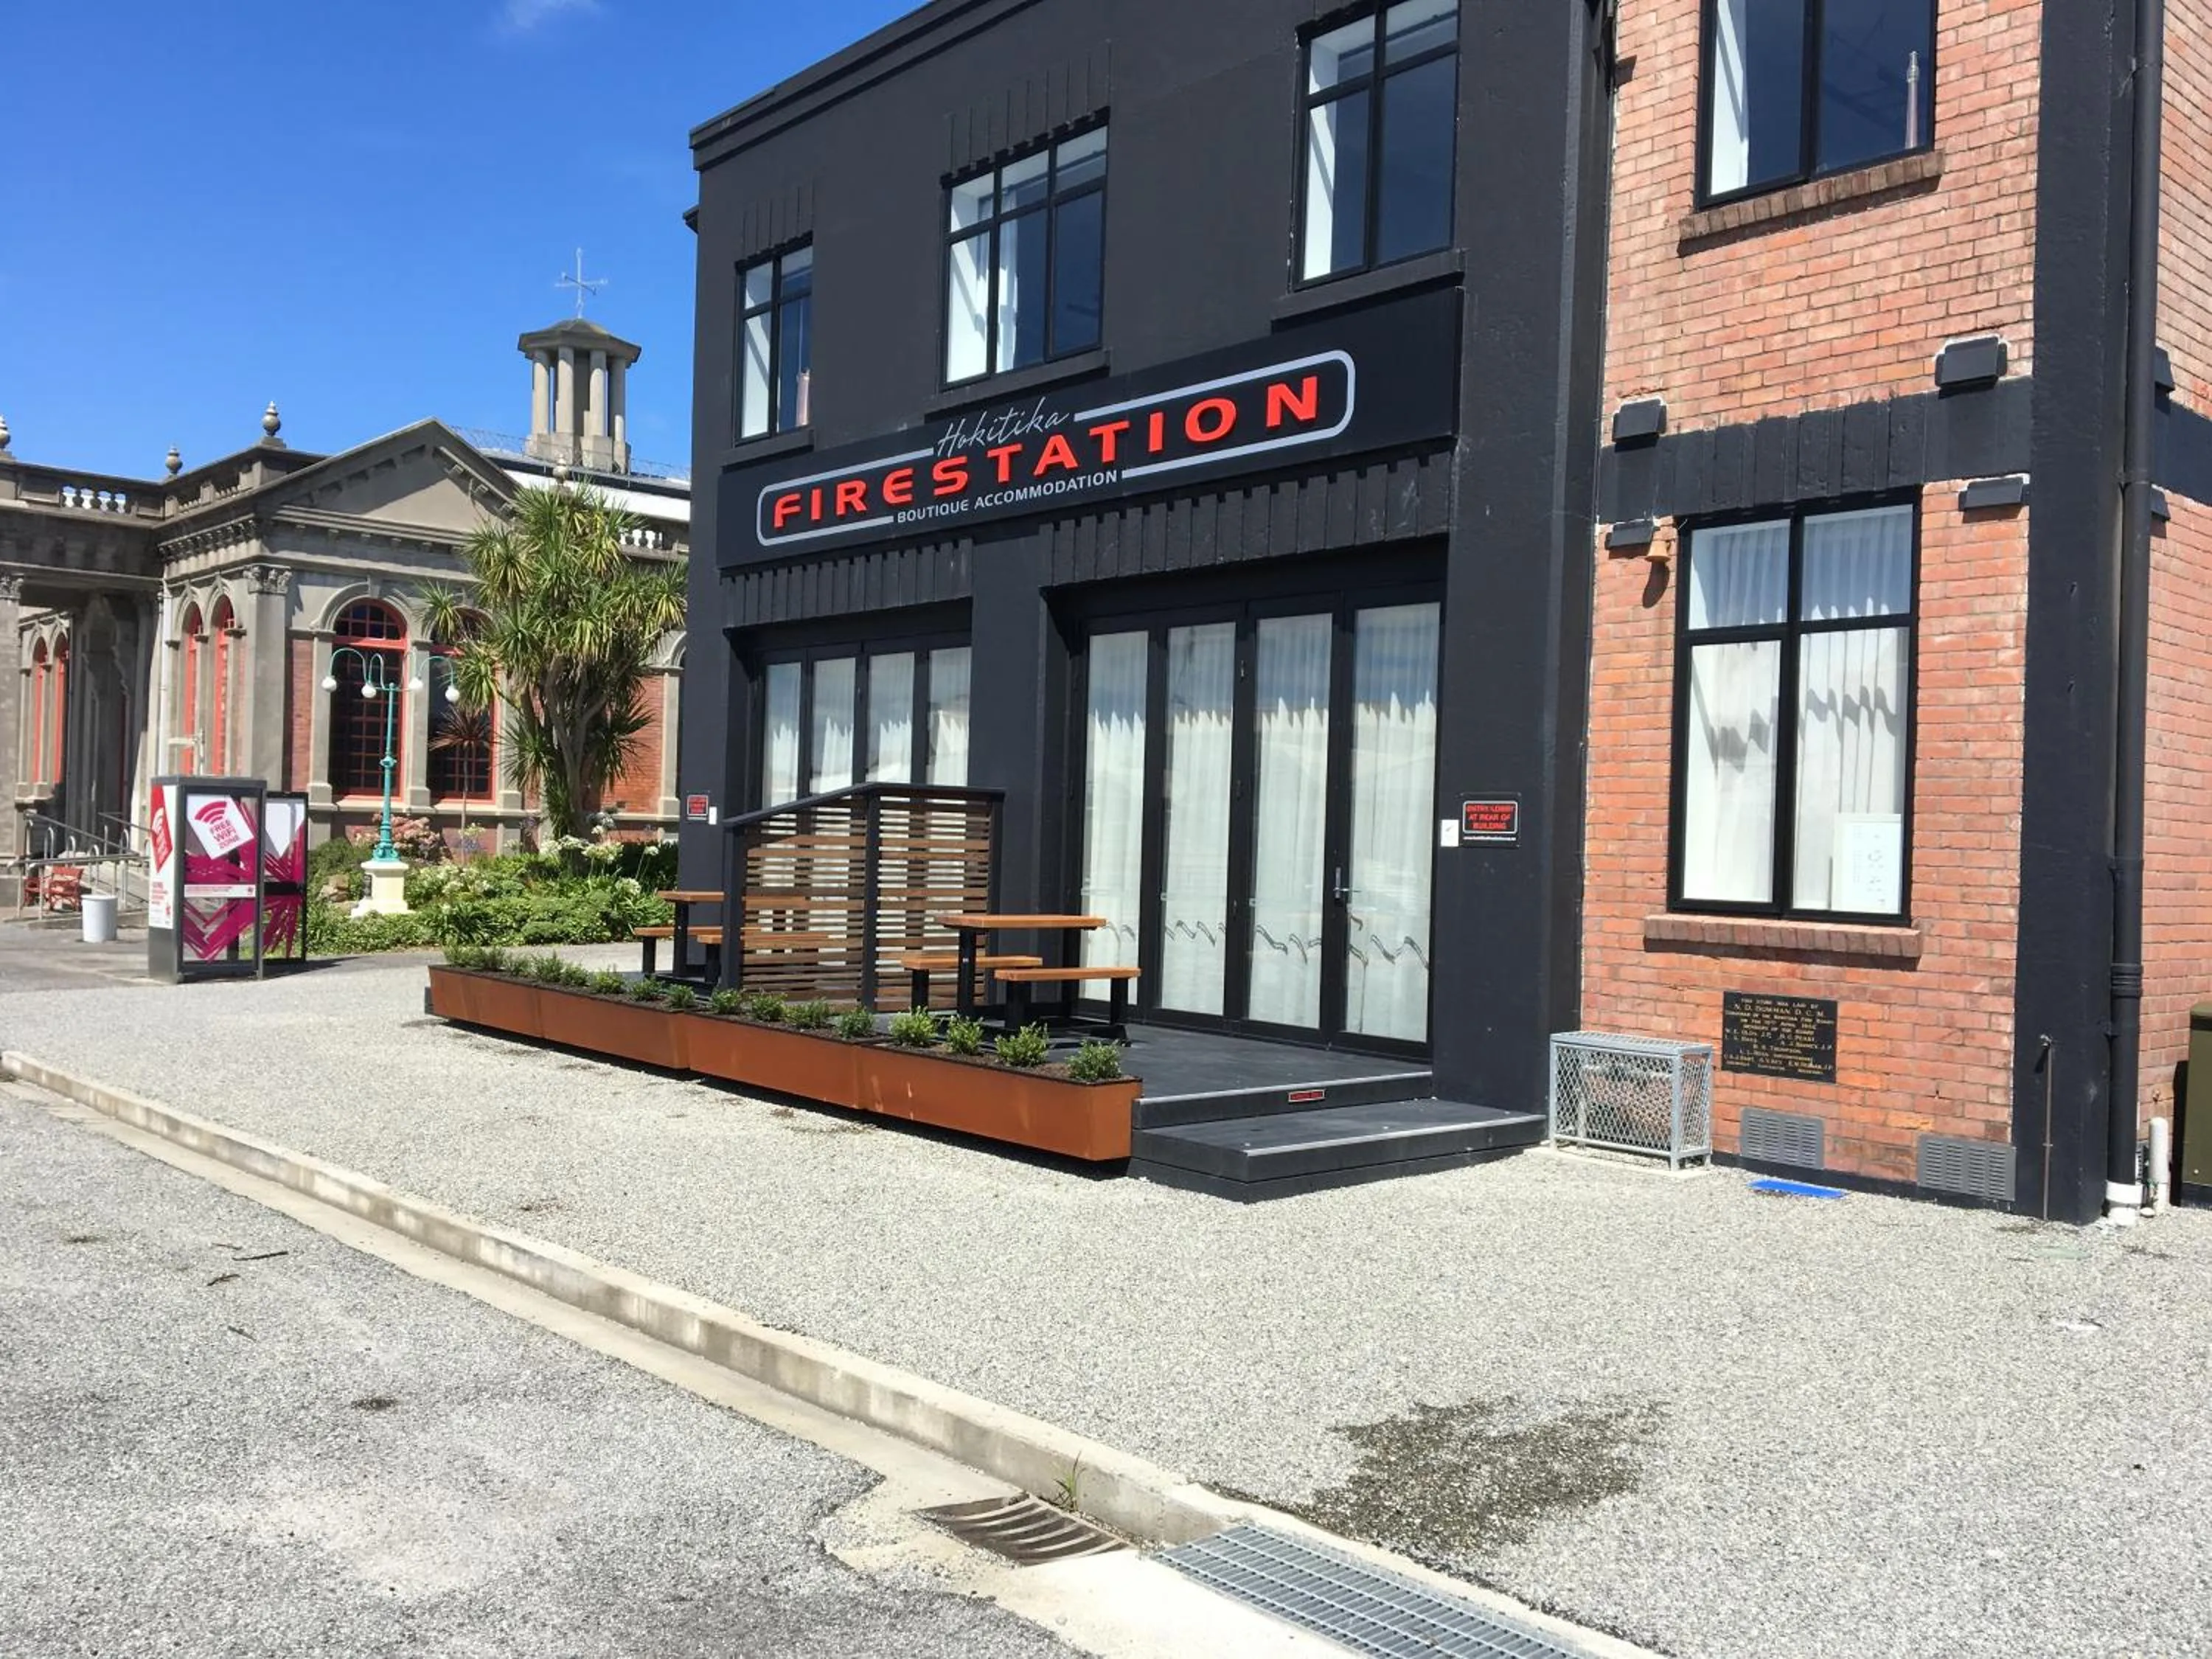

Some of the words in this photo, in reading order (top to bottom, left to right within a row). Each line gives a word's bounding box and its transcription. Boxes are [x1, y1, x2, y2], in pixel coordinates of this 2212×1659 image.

[773, 375, 1318, 529] FIRESTATION
[936, 396, 1070, 458] Hokitika
[897, 498, 970, 524] BOUTIQUE
[973, 469, 1118, 509] ACCOMMODATION
